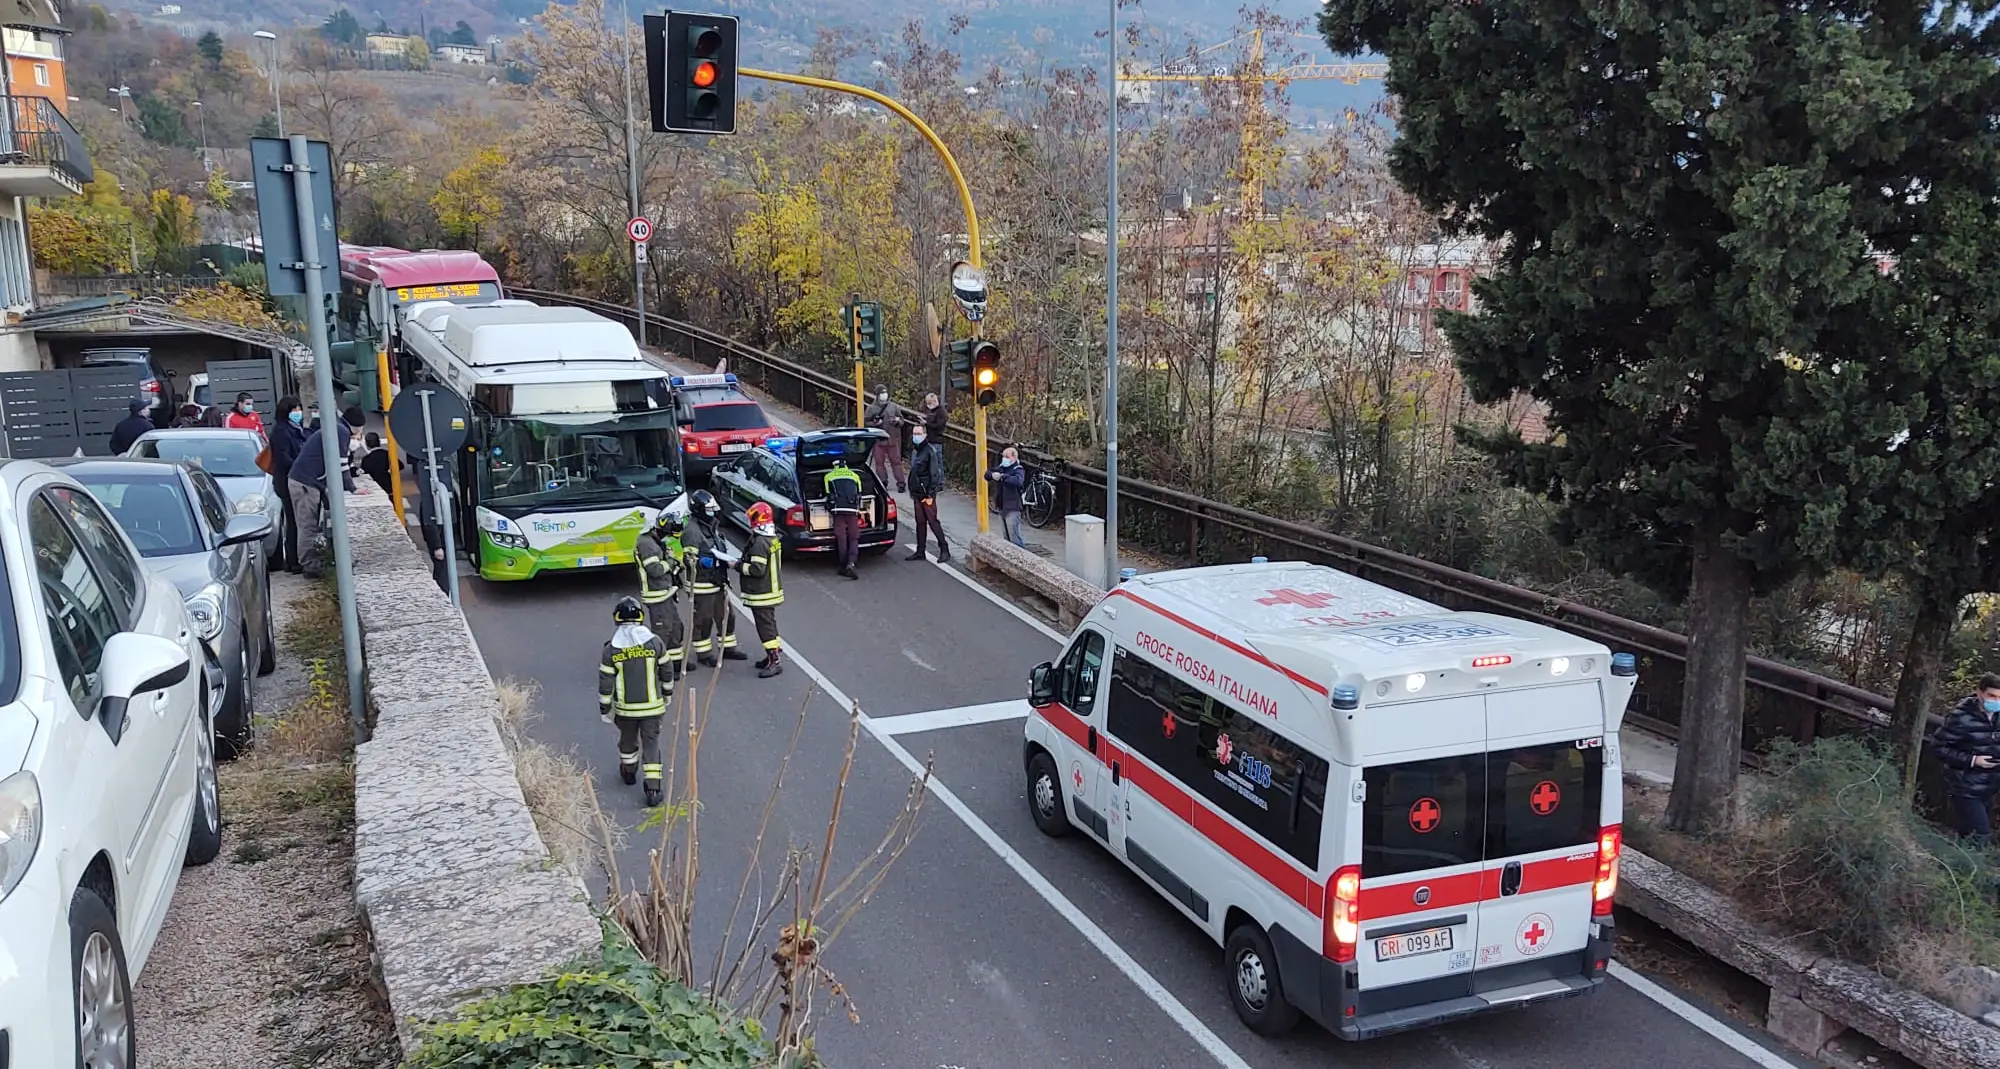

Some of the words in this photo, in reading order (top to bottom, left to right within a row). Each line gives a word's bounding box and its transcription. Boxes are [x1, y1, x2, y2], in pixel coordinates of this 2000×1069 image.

[634, 224, 647, 235] 40
[398, 288, 409, 301] 5
[532, 519, 576, 533] TRENTINO
[1381, 624, 1440, 633] 118
[1386, 628, 1493, 644] 21536
[612, 653, 628, 662] DEL
[629, 649, 656, 659] FUOCO
[1136, 631, 1174, 663] CROCE
[1175, 652, 1215, 687] ROSSA
[1218, 674, 1279, 720] ITALIANA
[1245, 756, 1272, 789] 118
[1381, 939, 1400, 957] CRI
[1407, 936, 1431, 952] 099
[1434, 931, 1448, 948] AF
